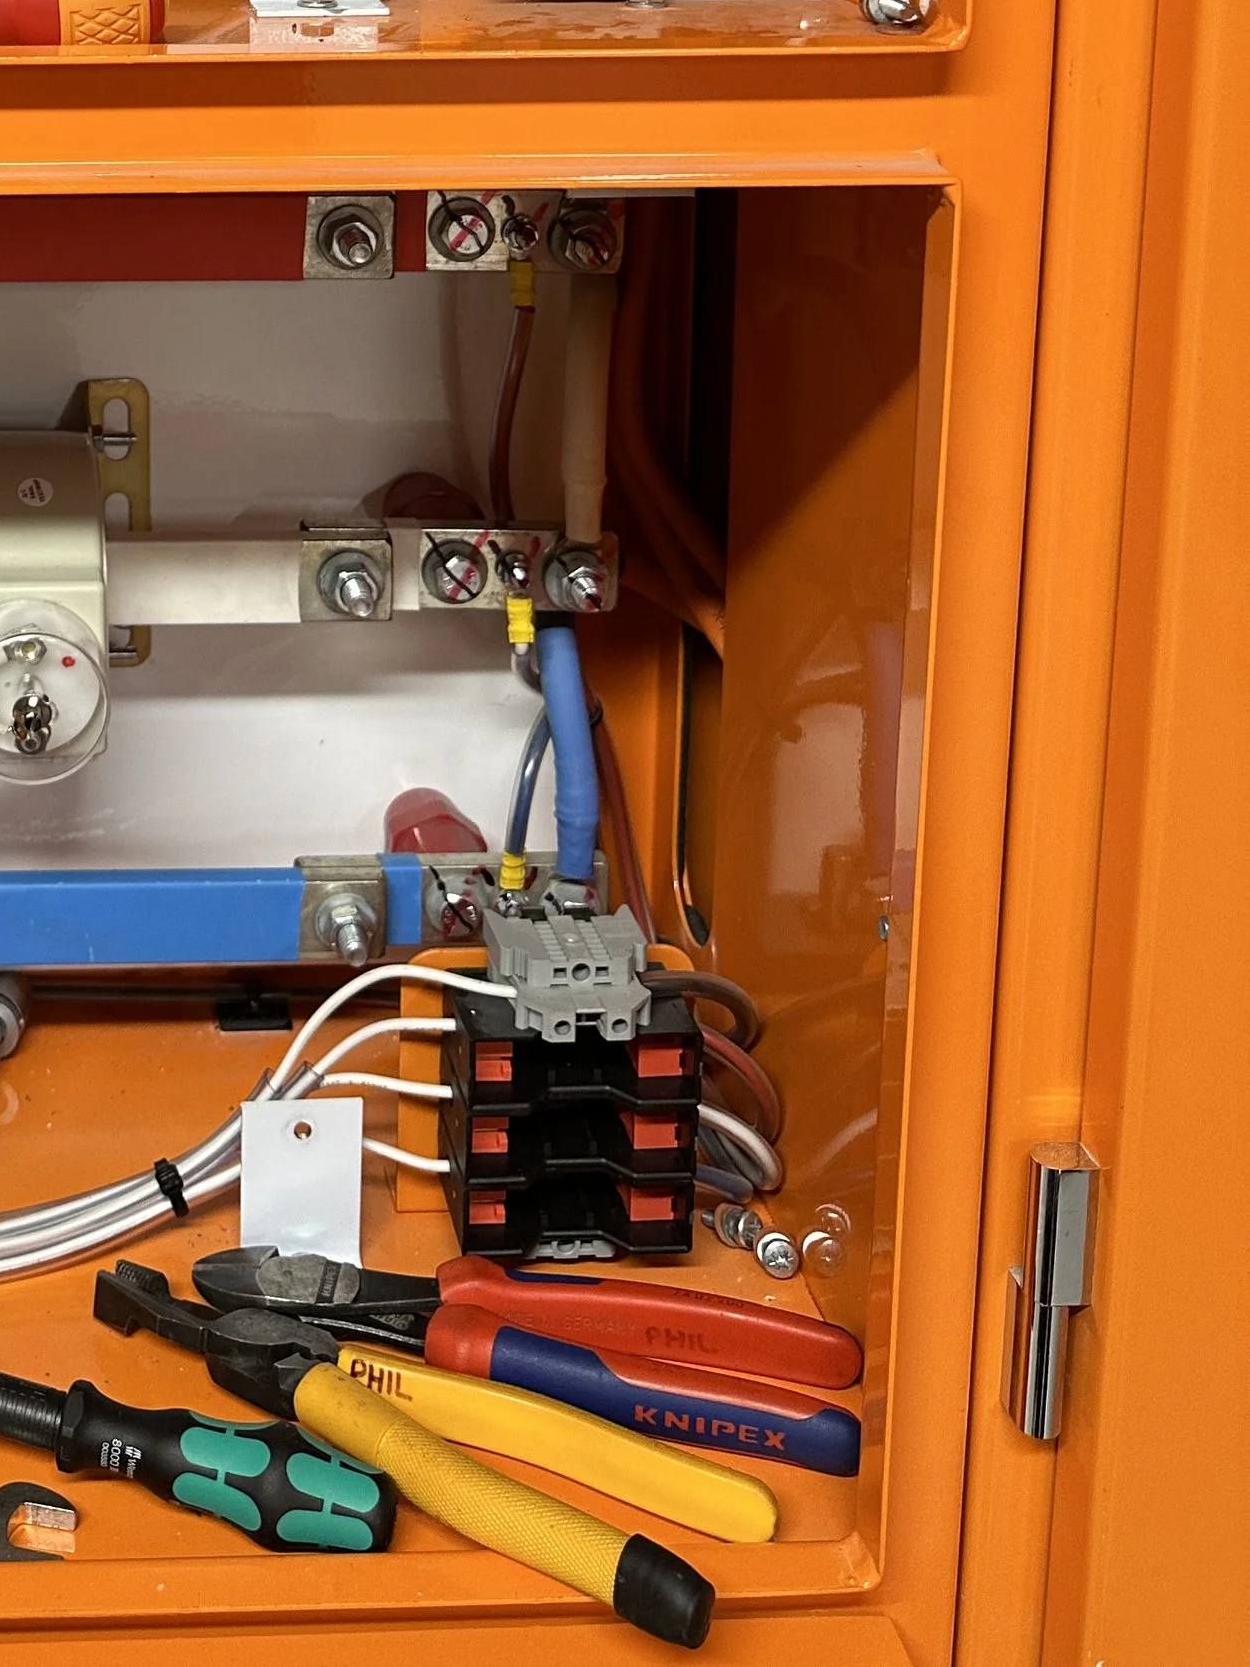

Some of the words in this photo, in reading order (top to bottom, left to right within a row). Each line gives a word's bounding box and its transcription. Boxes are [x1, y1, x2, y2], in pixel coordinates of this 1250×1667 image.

[321, 1263, 338, 1298] KNIPEX
[644, 1325, 718, 1355] PHIL
[350, 1358, 413, 1403] PHIL
[633, 1404, 787, 1452] KNIPEX
[109, 1438, 123, 1467] 8000
